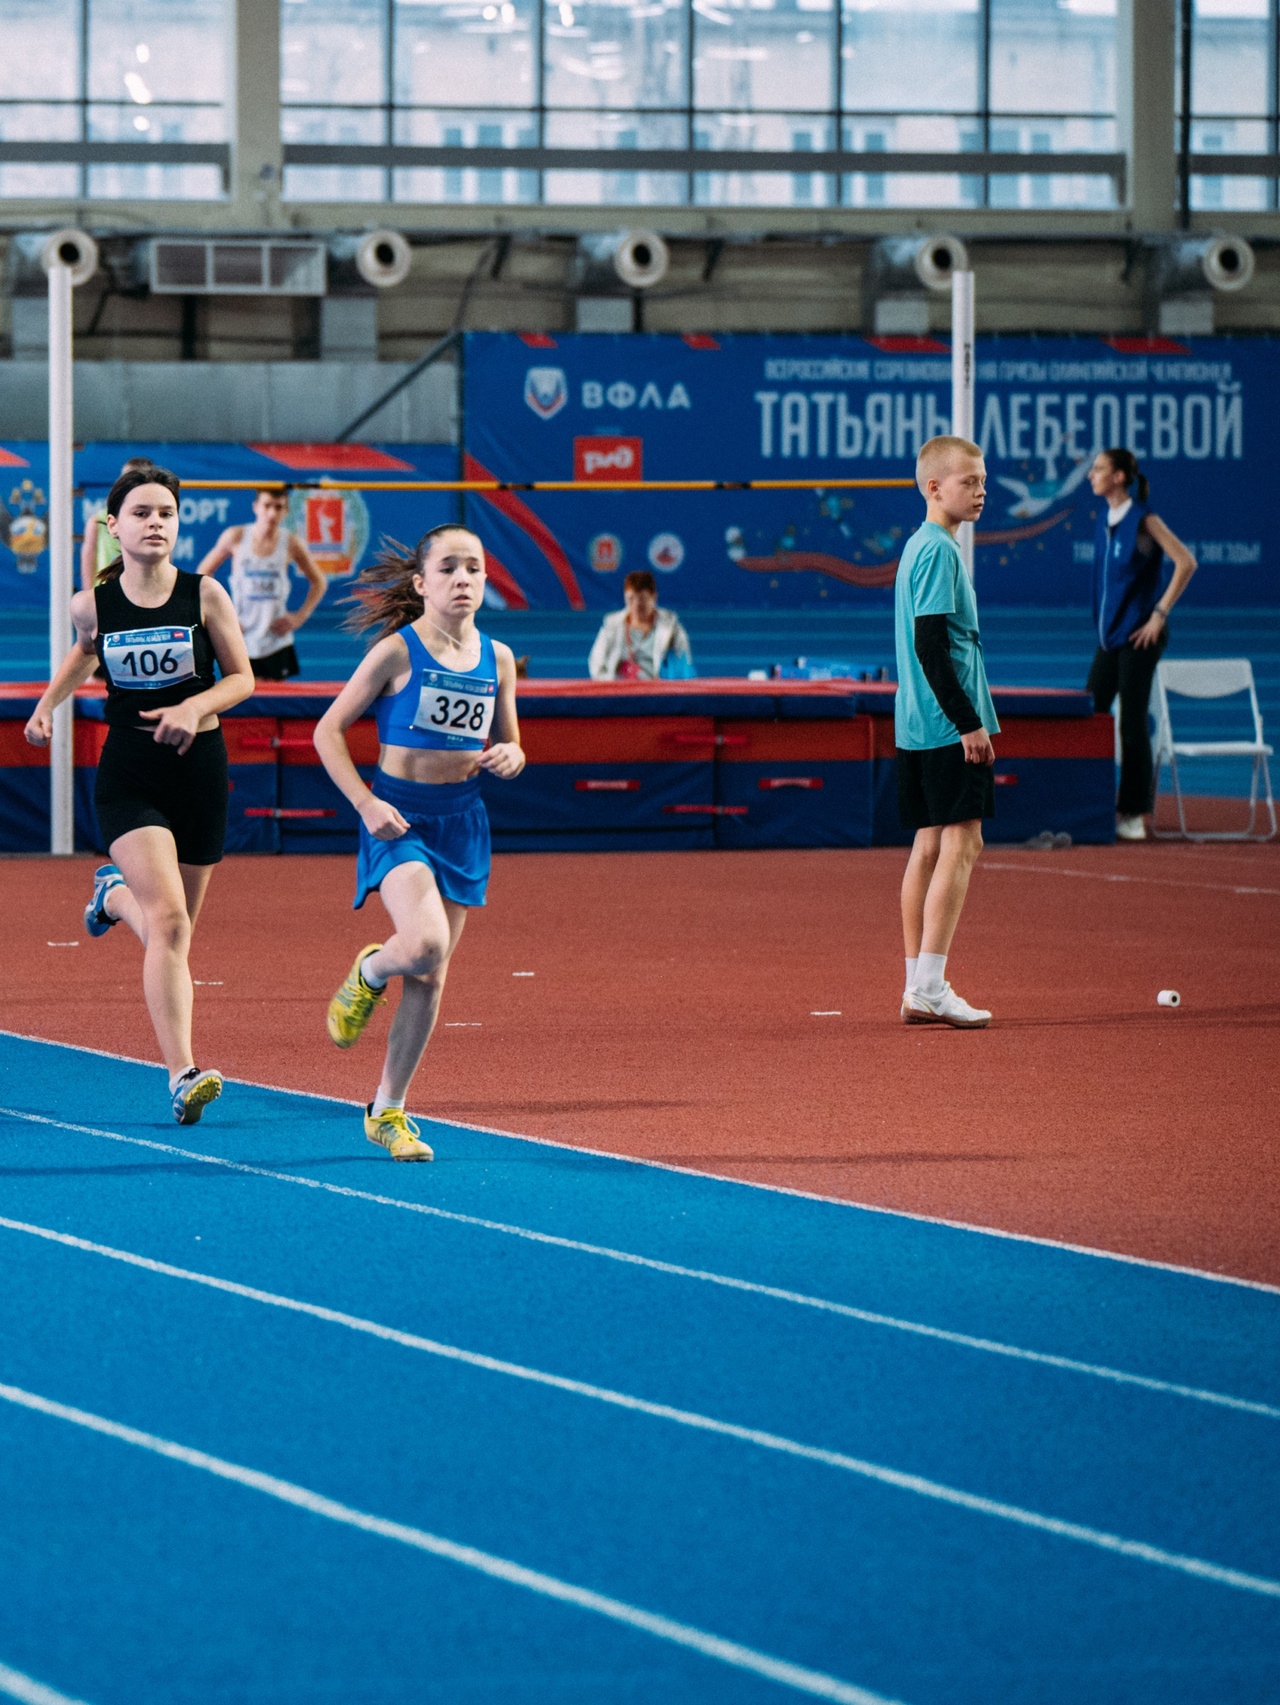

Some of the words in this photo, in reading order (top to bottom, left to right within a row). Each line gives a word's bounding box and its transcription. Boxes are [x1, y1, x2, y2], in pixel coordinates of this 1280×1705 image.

[582, 380, 692, 410] ВФЛА
[121, 648, 178, 677] 106
[431, 695, 485, 732] 328
